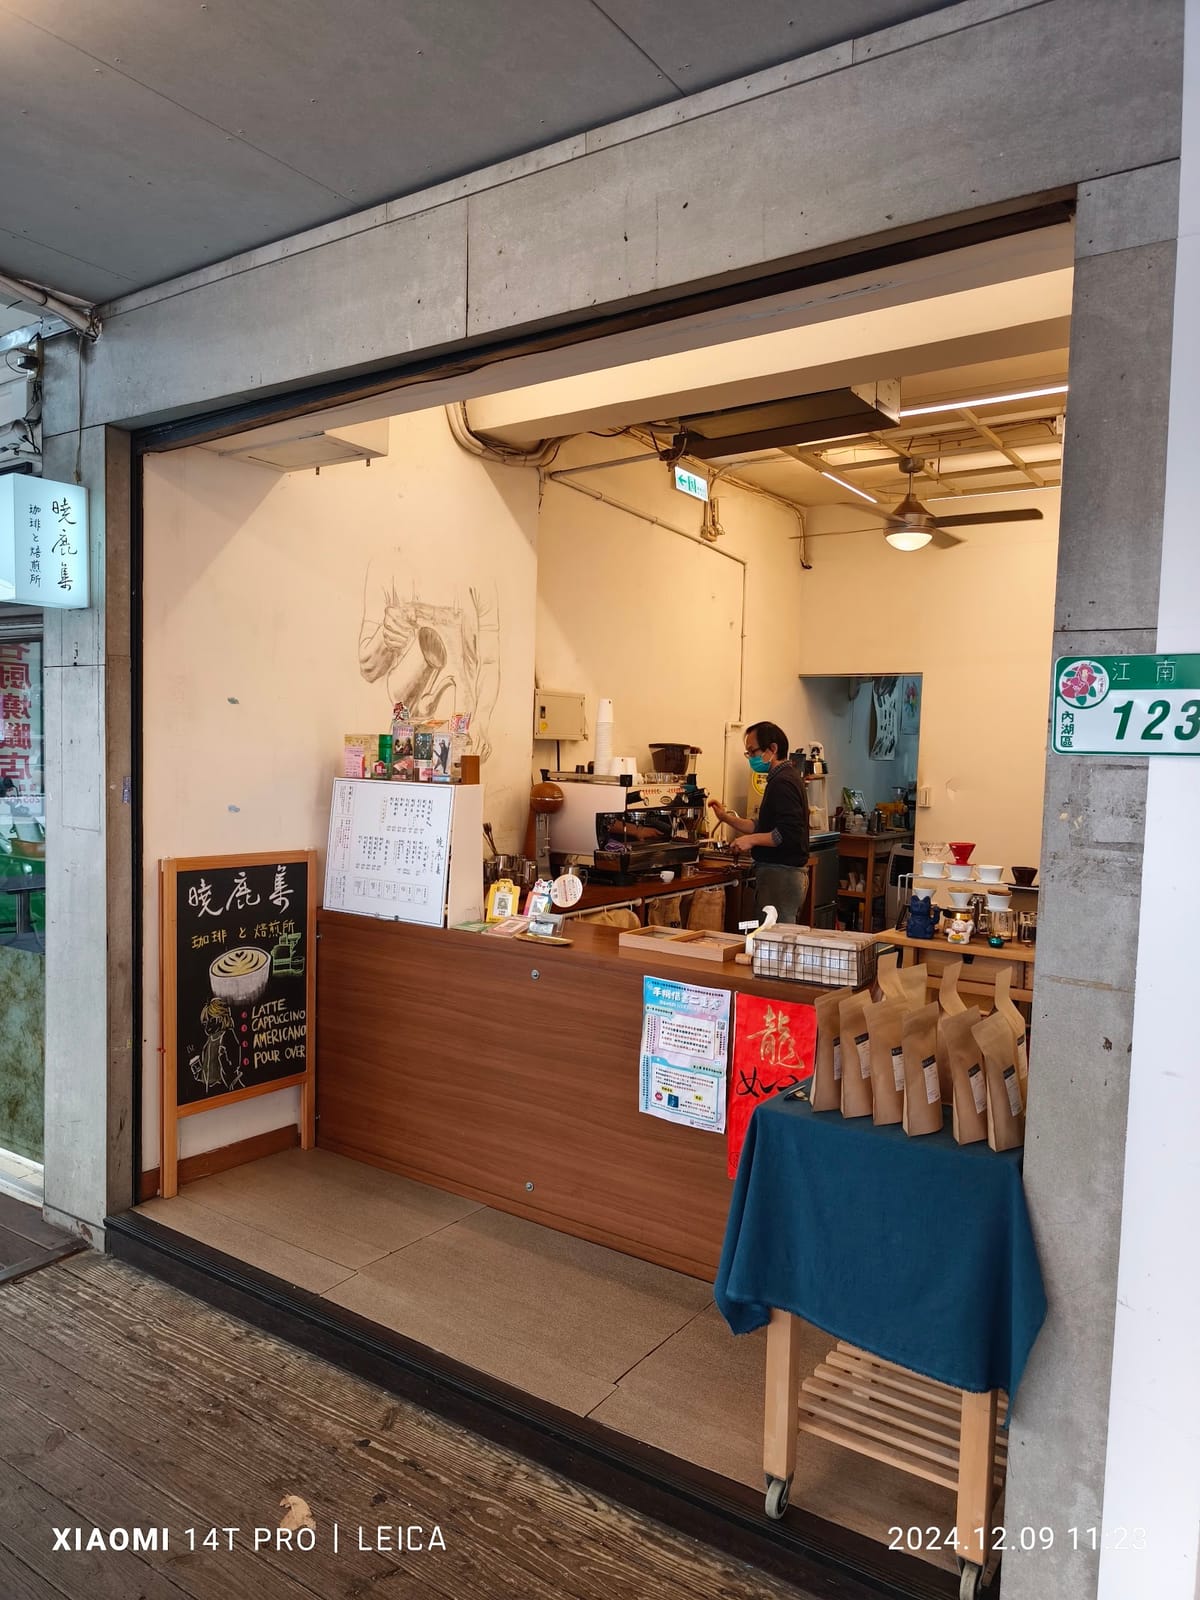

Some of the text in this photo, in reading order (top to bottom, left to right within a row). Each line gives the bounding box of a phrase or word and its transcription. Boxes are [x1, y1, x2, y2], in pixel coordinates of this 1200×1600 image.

[1060, 711, 1075, 748] 內湖區
[1113, 699, 1200, 741] 123
[188, 864, 295, 917] 曉鹿集
[251, 998, 287, 1019] LATTE
[251, 1009, 306, 1032] CAPPUCCINO
[253, 1024, 307, 1049] AMERICANO
[253, 1045, 306, 1069] POUR OVER
